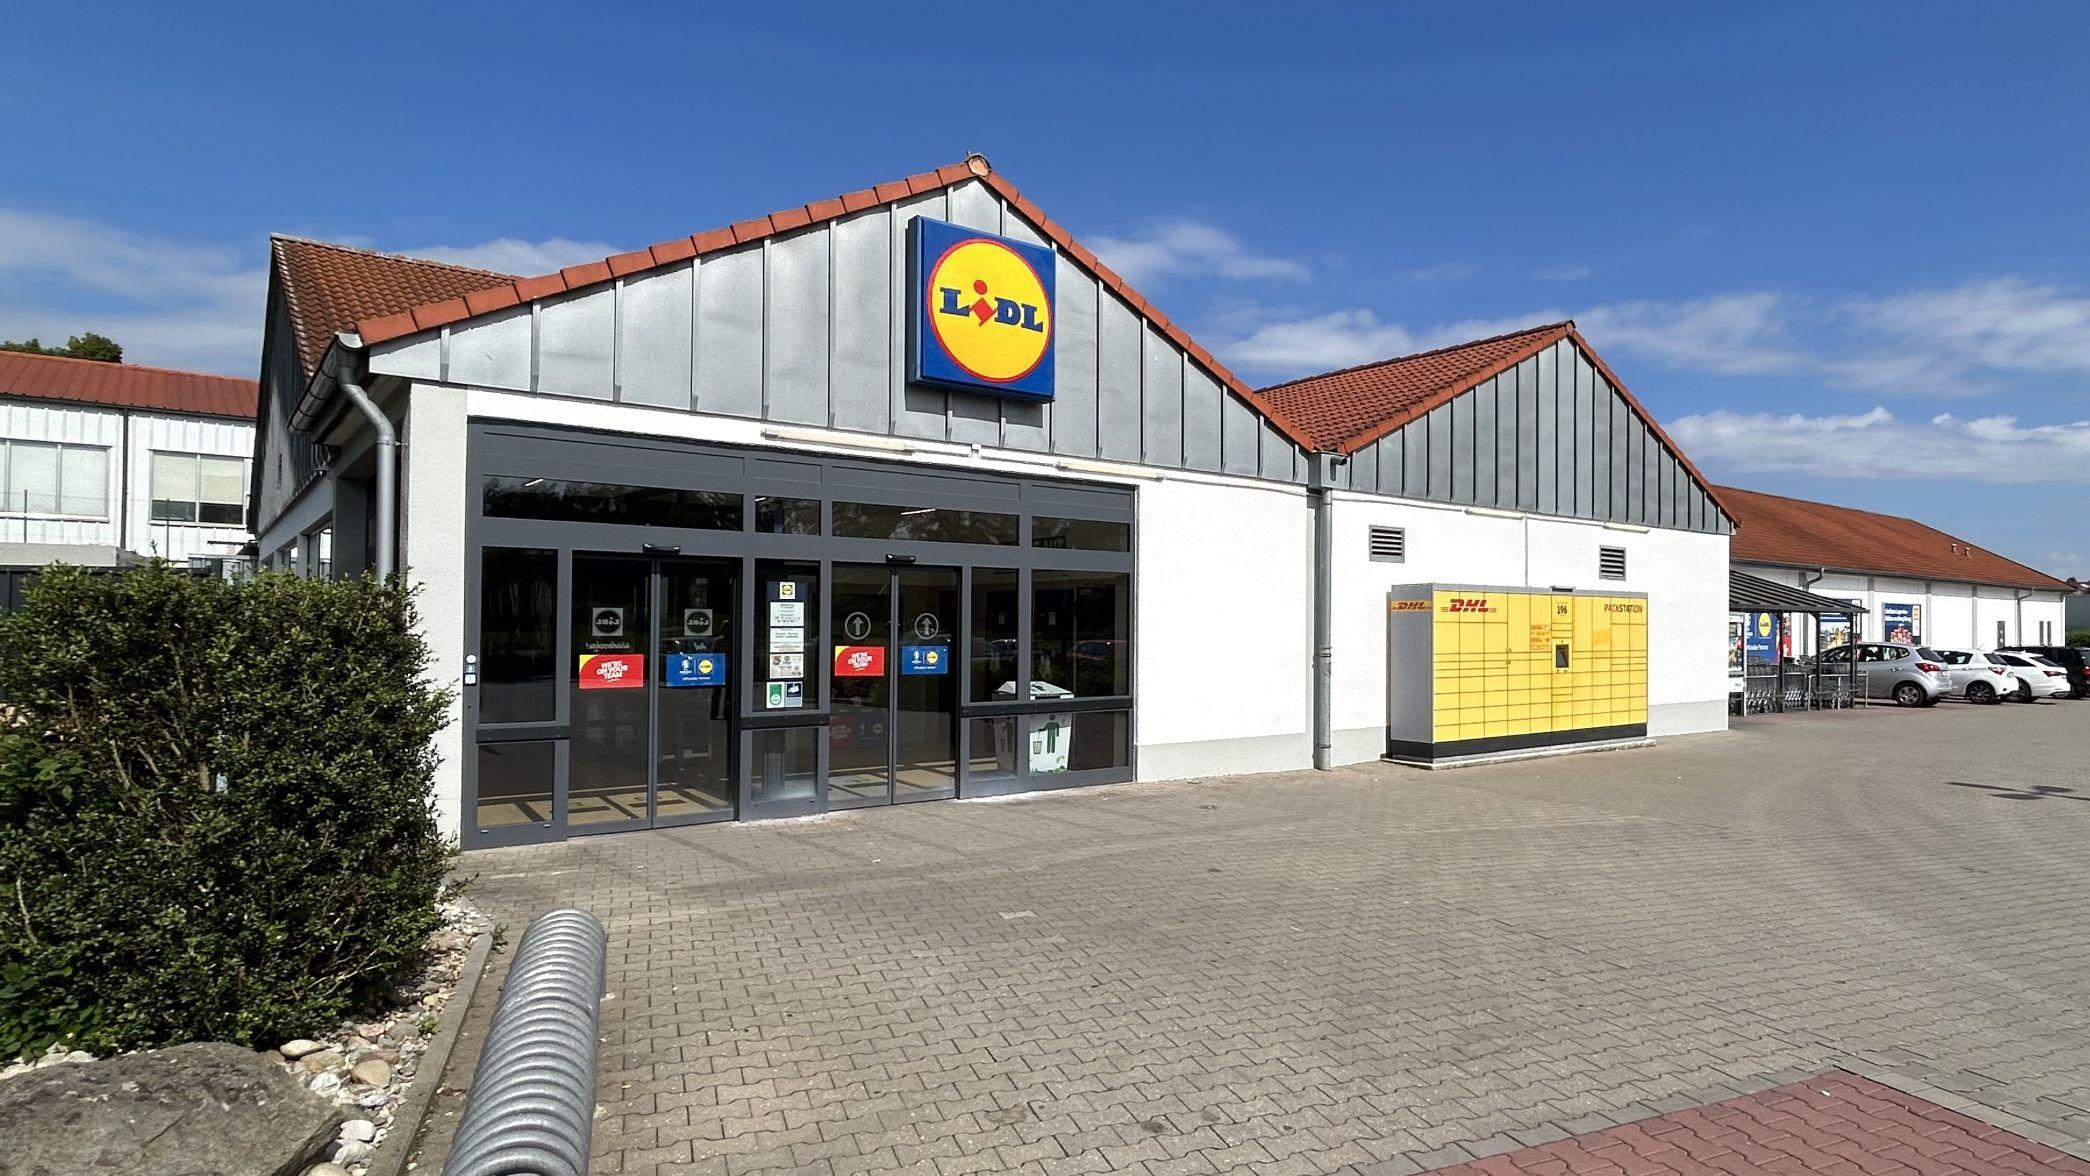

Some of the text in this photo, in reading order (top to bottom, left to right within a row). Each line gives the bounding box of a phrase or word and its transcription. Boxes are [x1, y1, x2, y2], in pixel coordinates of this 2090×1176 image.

[1397, 601, 1426, 610] DHL
[1450, 599, 1489, 612] DHL
[1604, 603, 1643, 613] PACKSTATION
